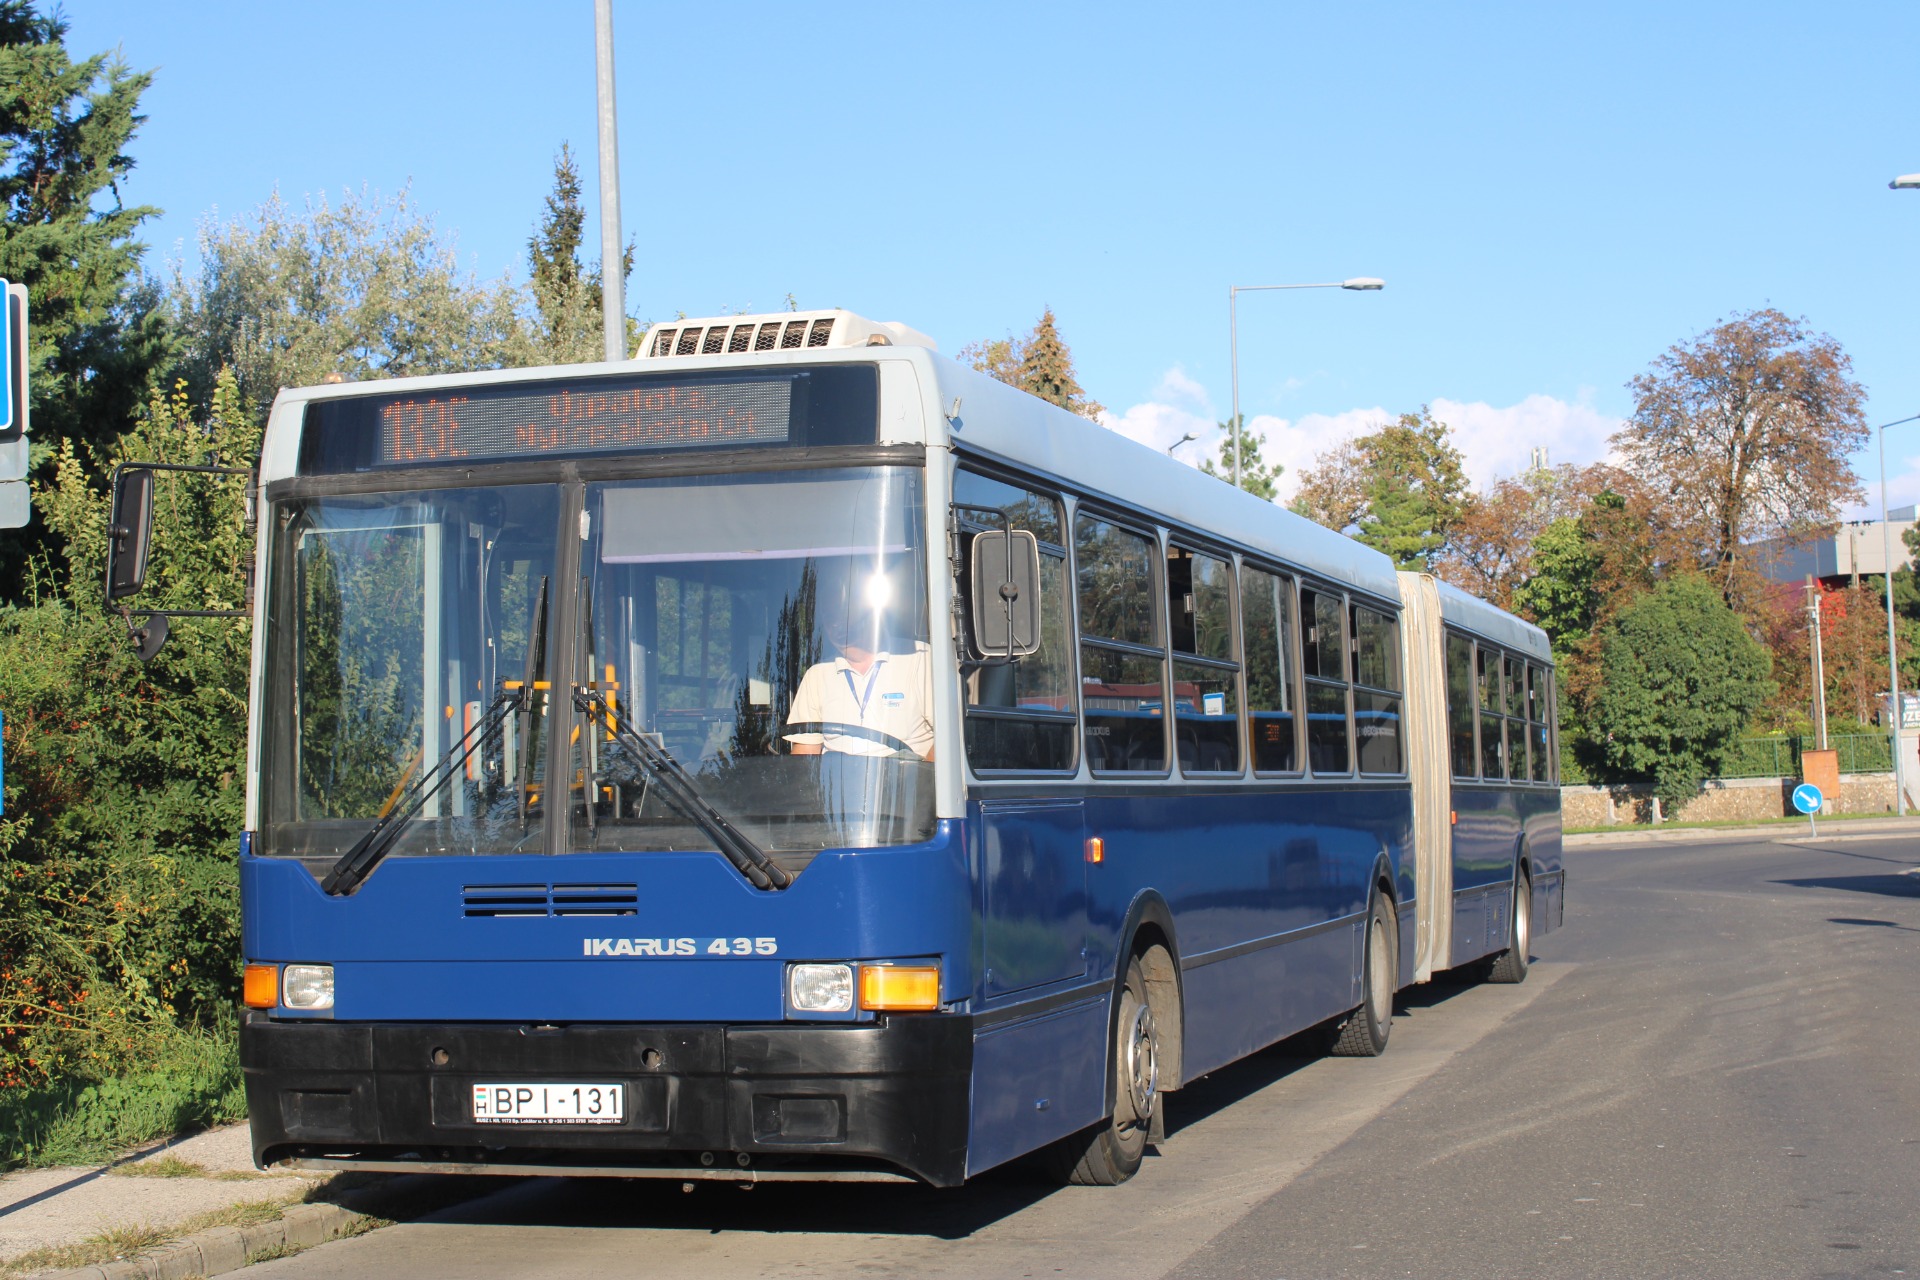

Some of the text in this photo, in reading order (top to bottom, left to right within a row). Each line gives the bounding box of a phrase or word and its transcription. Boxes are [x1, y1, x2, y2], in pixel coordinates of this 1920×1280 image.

[583, 937, 778, 956] IKARUS 435
[476, 1102, 487, 1114] H
[495, 1088, 617, 1114] BPI-131
